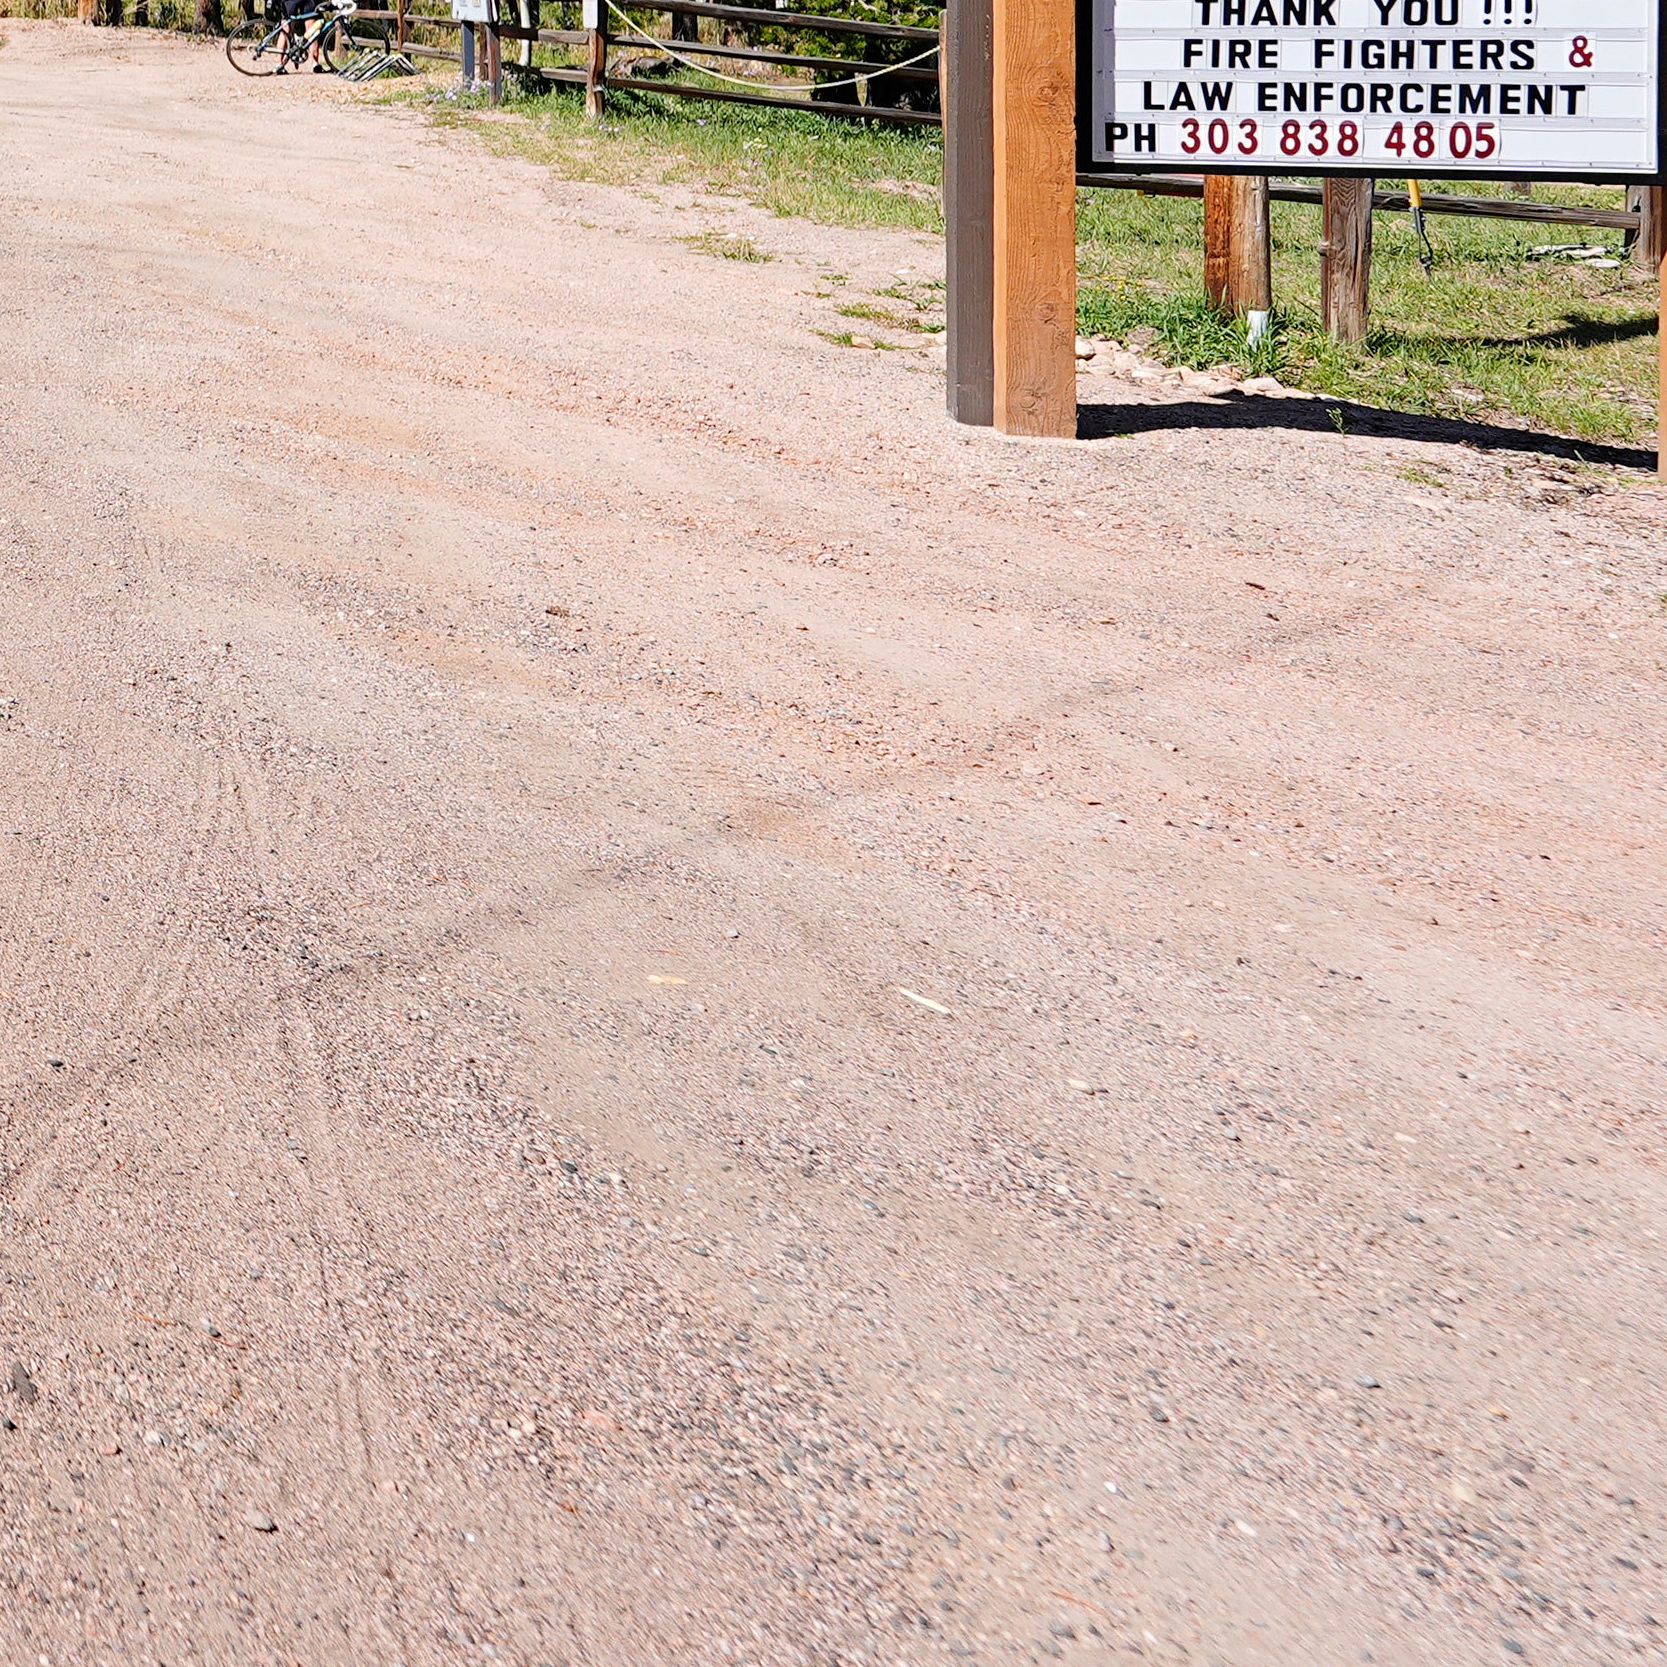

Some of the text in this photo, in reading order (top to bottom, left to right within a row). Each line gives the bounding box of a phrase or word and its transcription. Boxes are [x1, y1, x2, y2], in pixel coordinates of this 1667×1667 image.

[1183, 35, 1594, 70] FIRE FIGHTERS &
[1143, 80, 1586, 116] LAW ENFORCEMENT
[1104, 122, 1157, 152] PH
[1181, 117, 1259, 156] 303
[1280, 119, 1359, 157] 838
